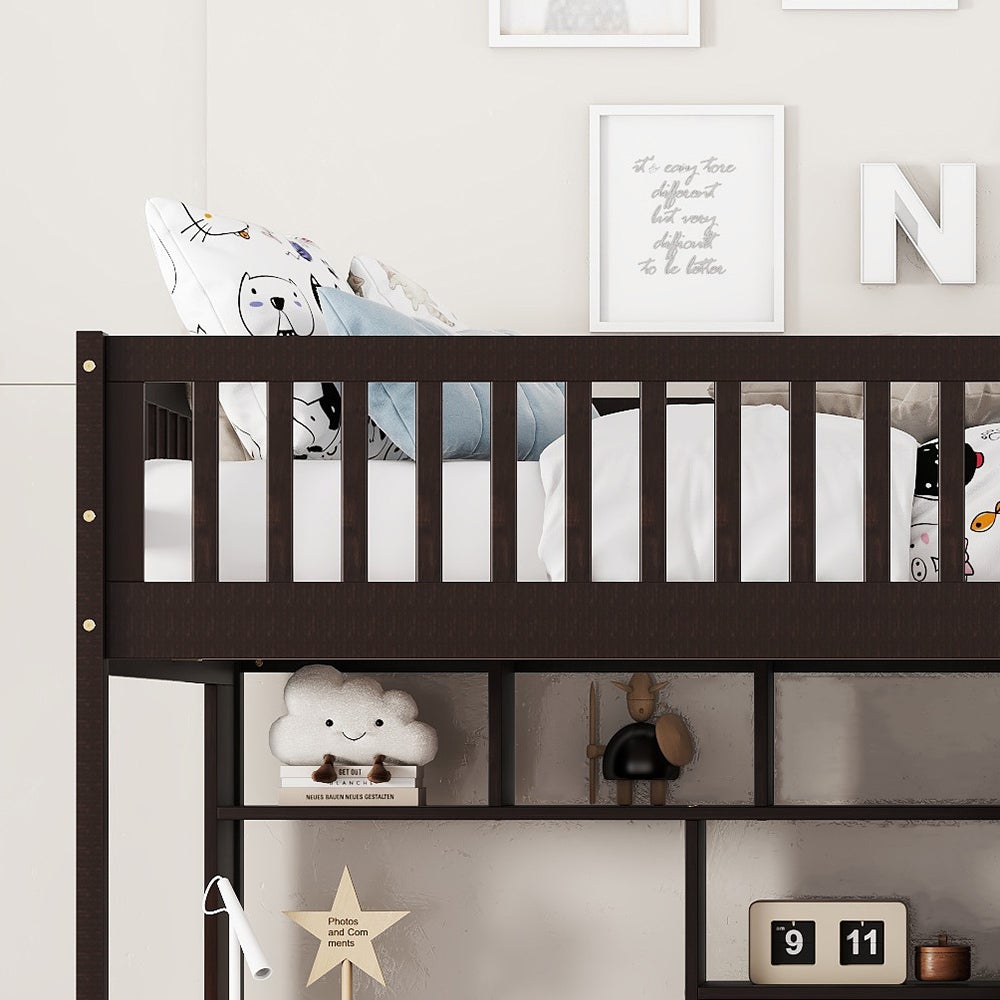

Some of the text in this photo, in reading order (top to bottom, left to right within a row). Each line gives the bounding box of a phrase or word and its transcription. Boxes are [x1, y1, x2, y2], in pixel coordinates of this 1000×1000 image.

[860, 163, 977, 285] N
[638, 257, 657, 275] to
[338, 768, 362, 776] GET OUT
[328, 917, 359, 926] Photos
[328, 928, 369, 936] and Com
[328, 939, 355, 947] ments
[785, 928, 877, 956] 9 11
